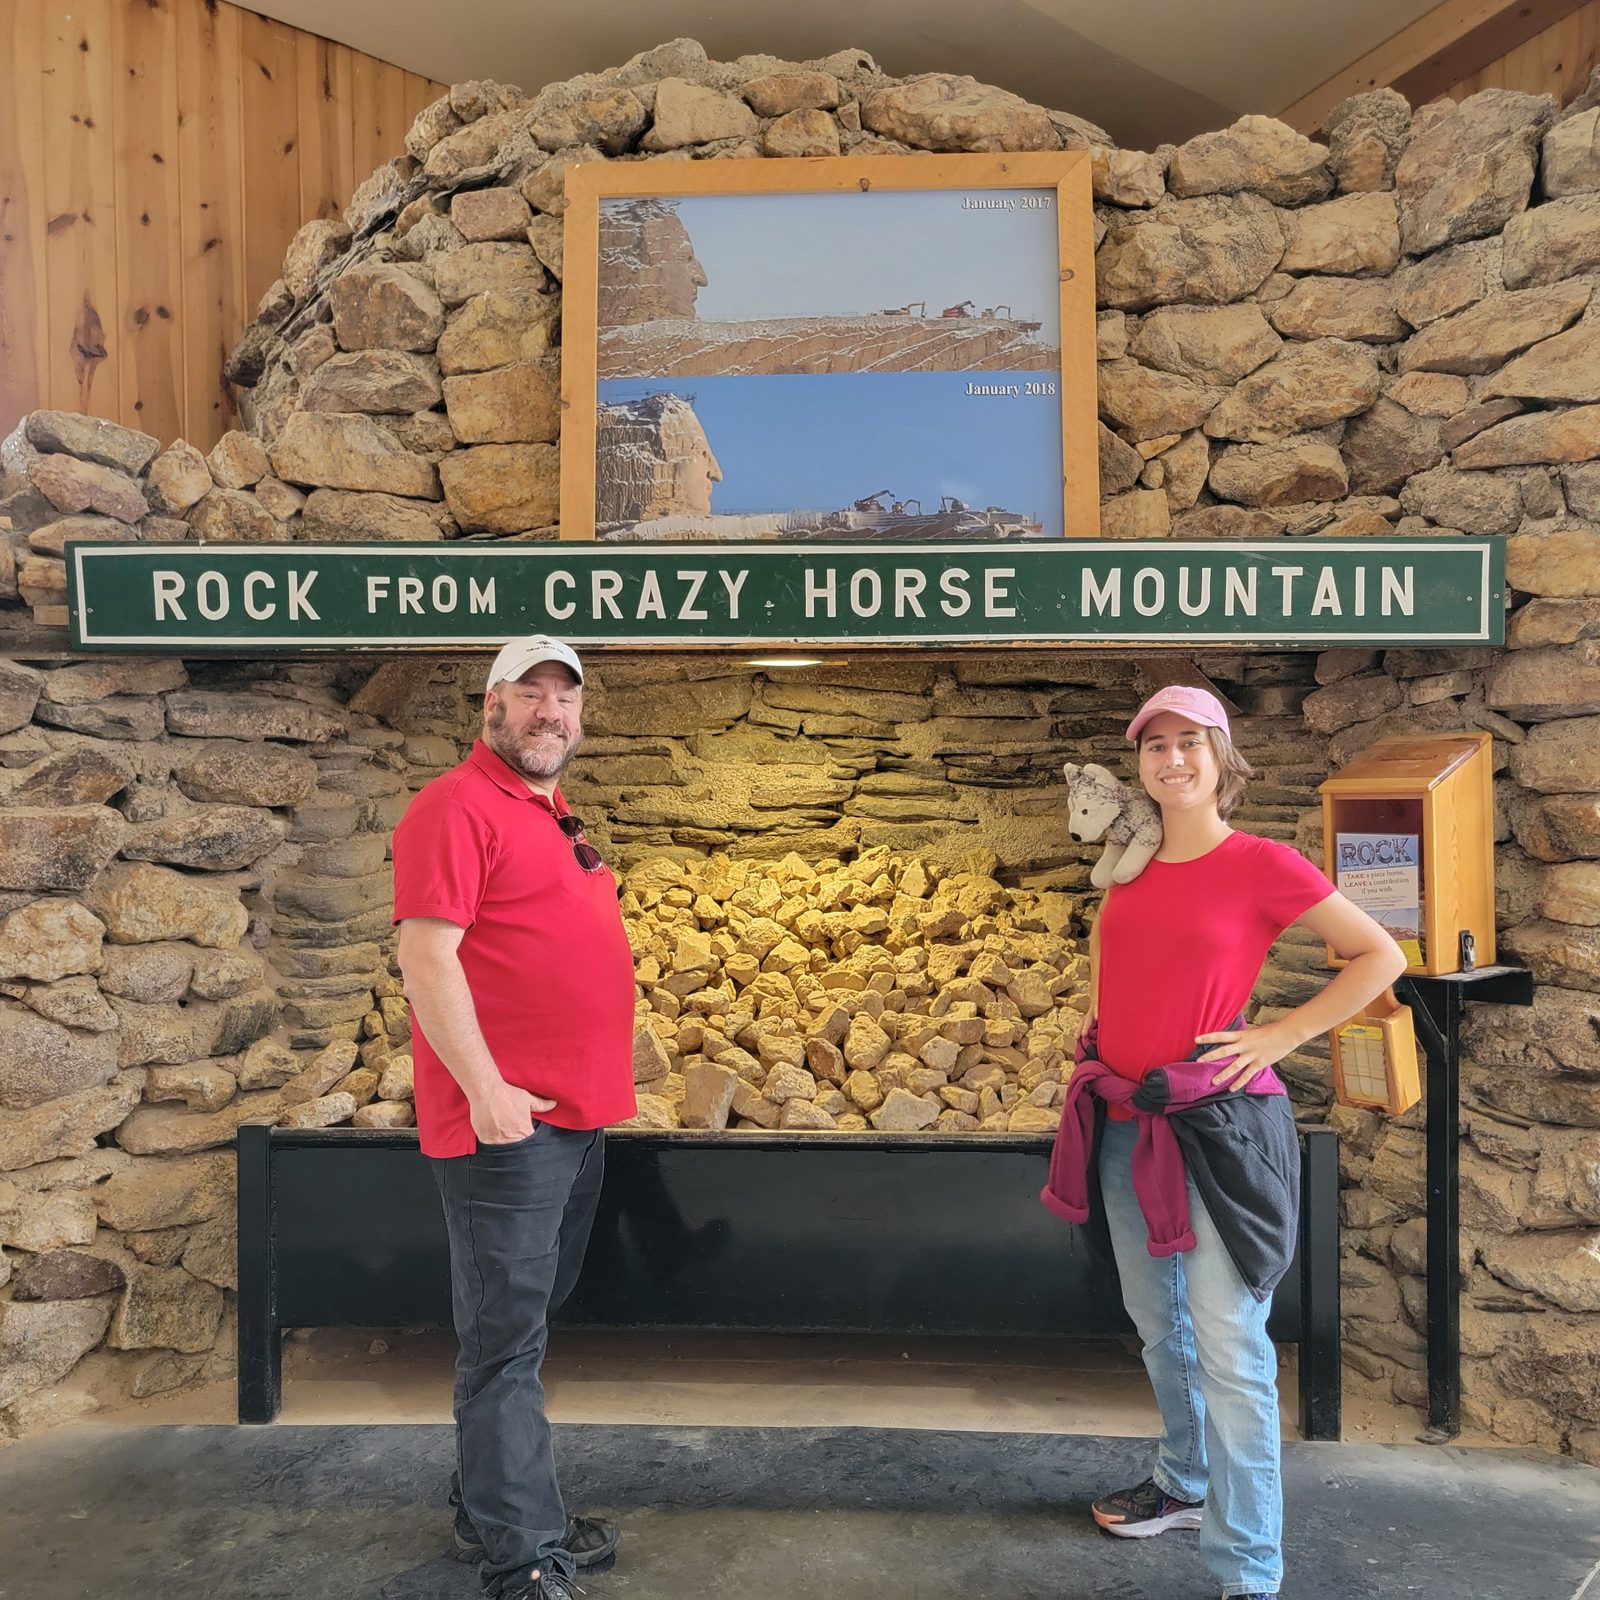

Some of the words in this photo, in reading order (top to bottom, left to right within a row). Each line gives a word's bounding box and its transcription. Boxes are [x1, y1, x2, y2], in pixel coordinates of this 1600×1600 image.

[962, 197, 1015, 212] January
[1020, 197, 1051, 209] 2017
[965, 382, 1020, 398] January
[1024, 382, 1056, 395] 2018
[152, 570, 321, 622] ROCK
[366, 574, 496, 615] FROM
[545, 569, 750, 621] CRAZY
[804, 568, 1017, 619] HORSE
[1081, 566, 1415, 618] MOUNTAIN
[1340, 837, 1413, 867] ROCK
